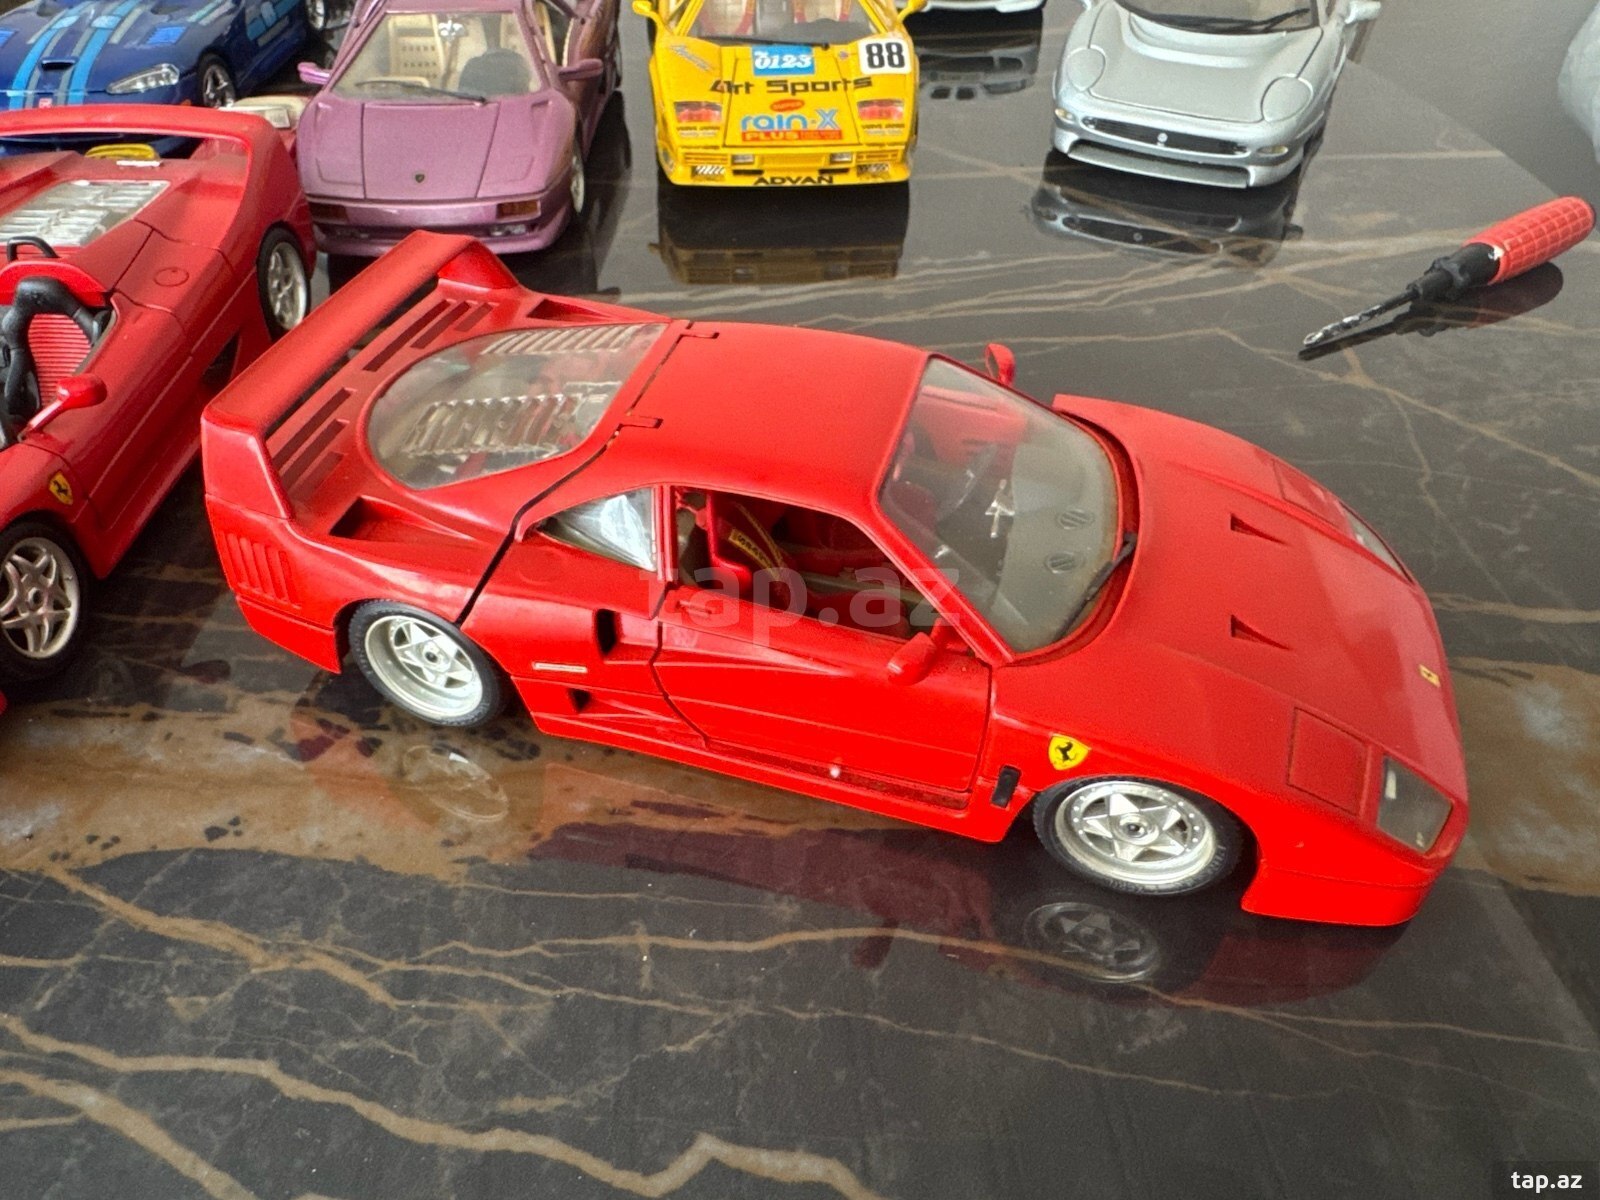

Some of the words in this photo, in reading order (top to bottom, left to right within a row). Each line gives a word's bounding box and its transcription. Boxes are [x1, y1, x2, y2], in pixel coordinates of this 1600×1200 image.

[865, 42, 906, 69] 88
[710, 80, 754, 95] Art
[766, 77, 873, 96] Sports
[741, 108, 840, 131] rain-X
[744, 130, 800, 141] PLUS
[753, 175, 834, 186] ADVAN
